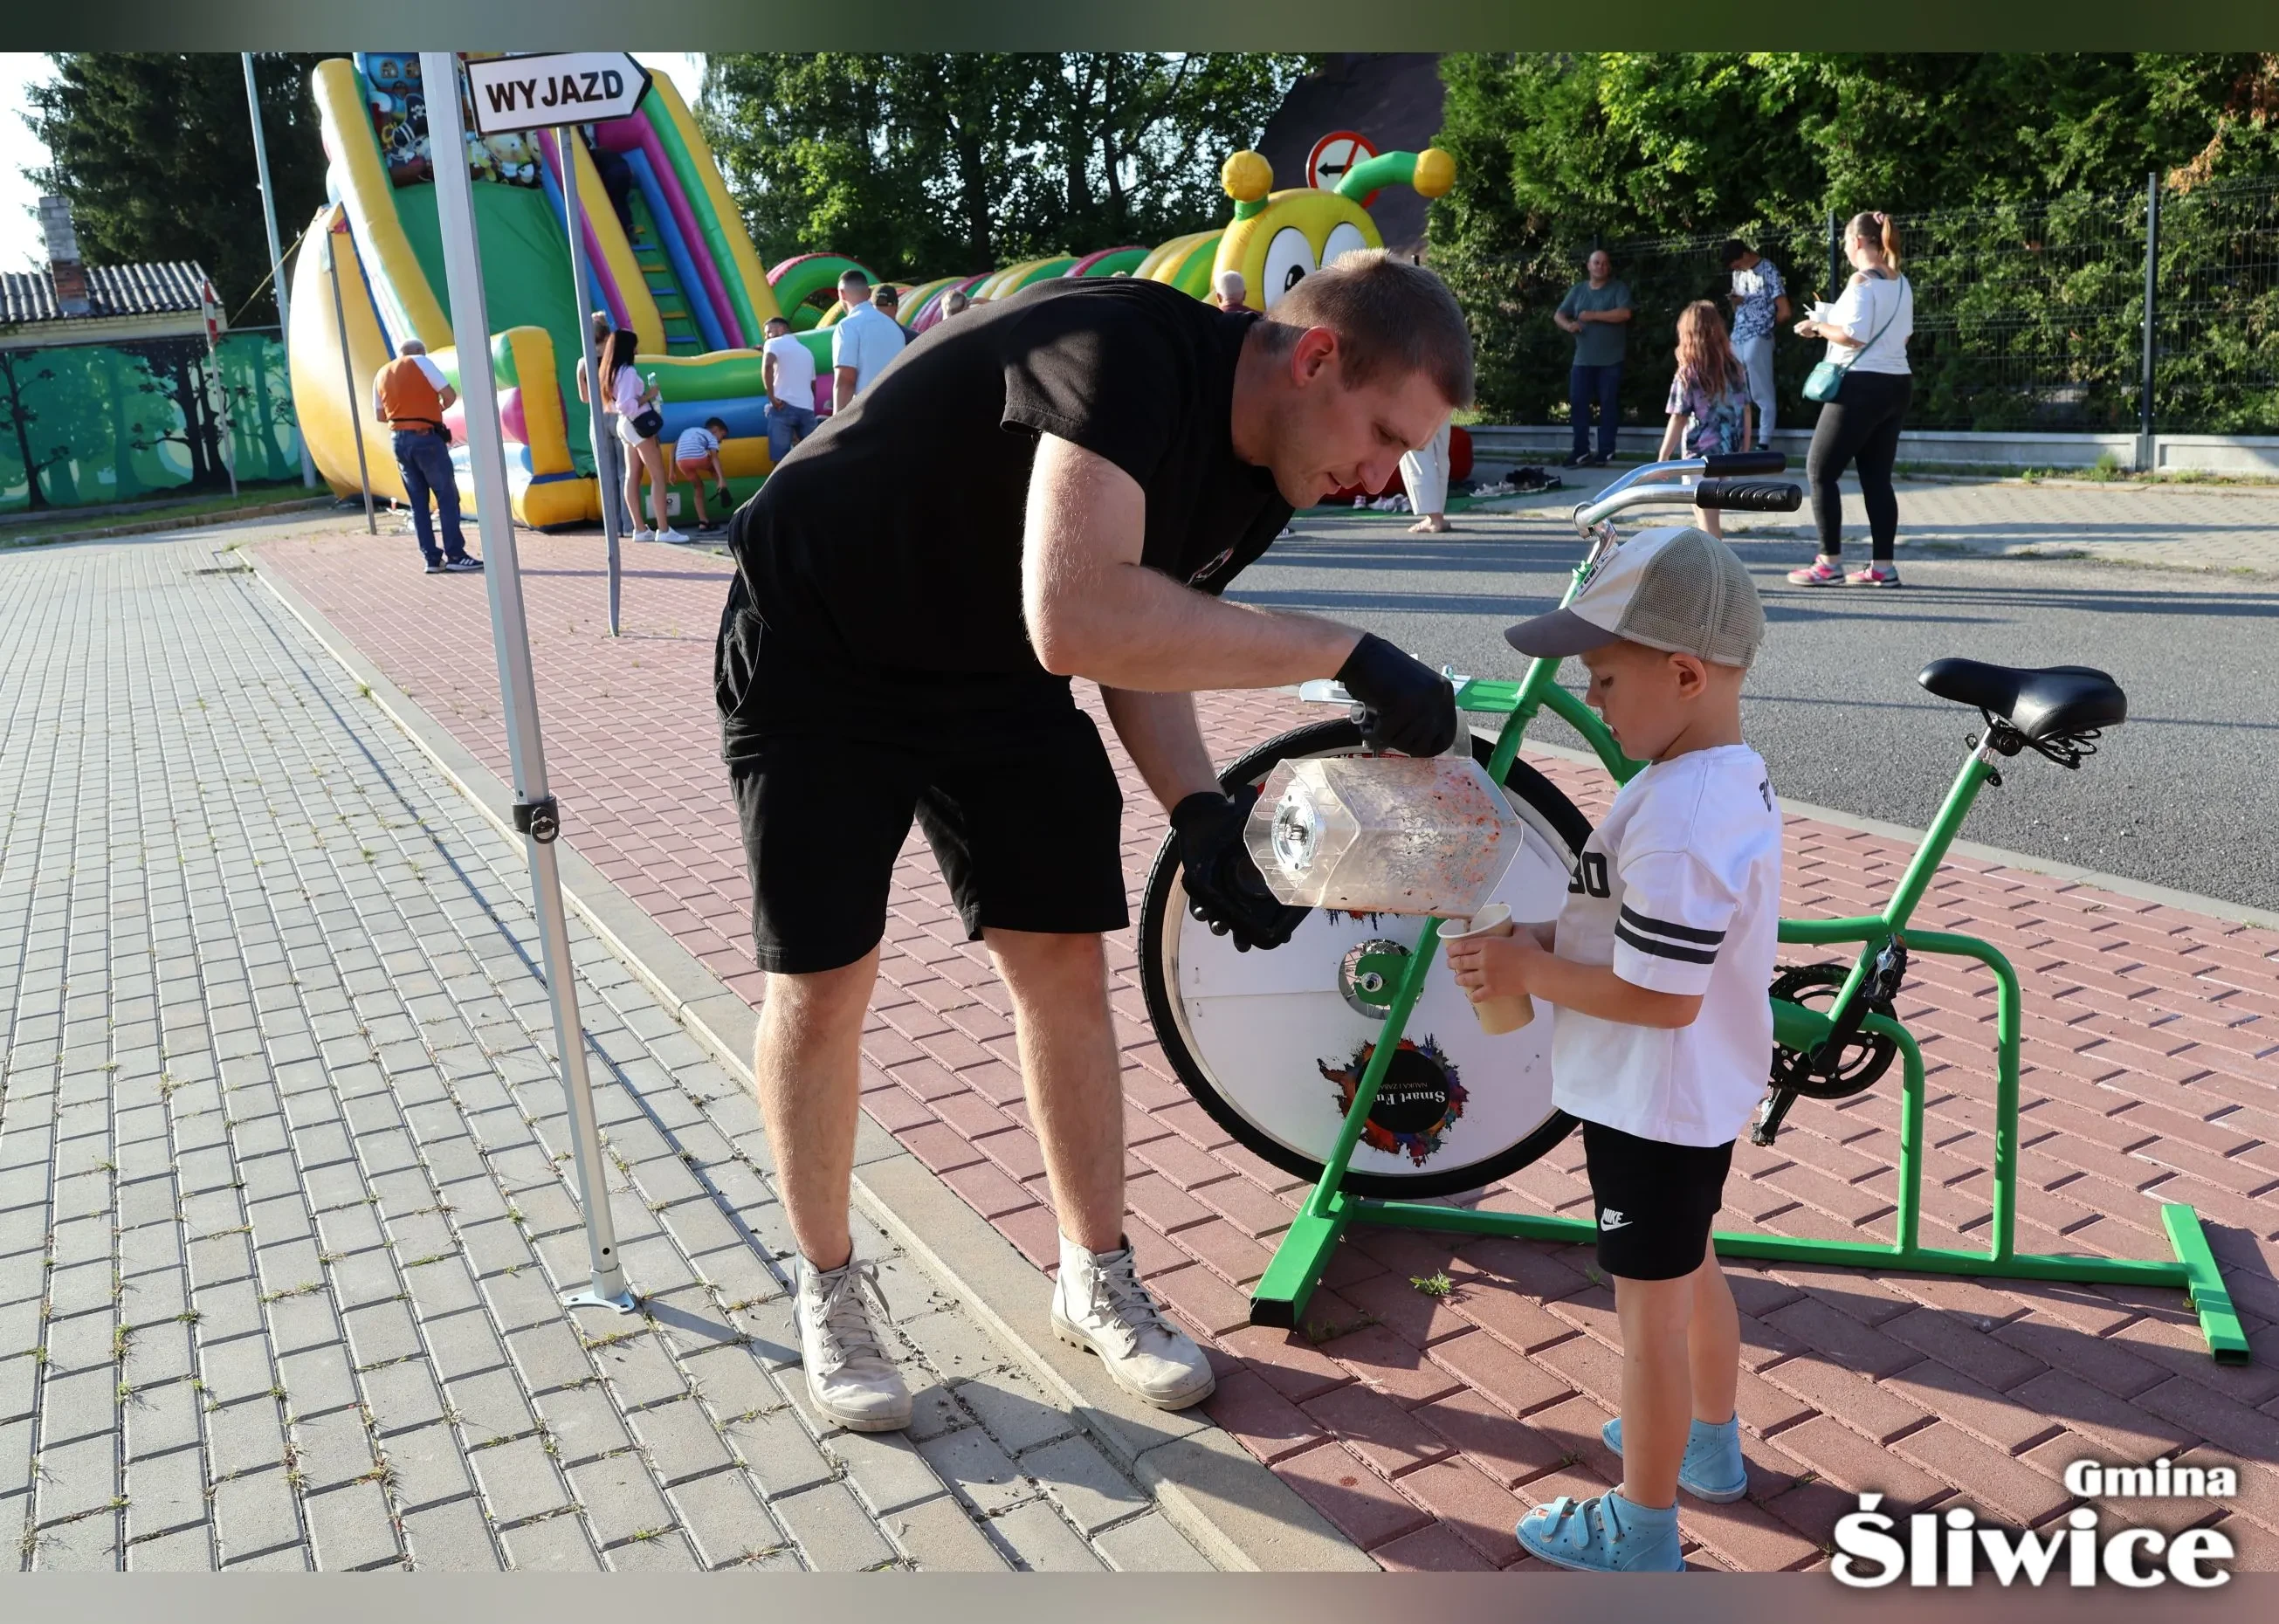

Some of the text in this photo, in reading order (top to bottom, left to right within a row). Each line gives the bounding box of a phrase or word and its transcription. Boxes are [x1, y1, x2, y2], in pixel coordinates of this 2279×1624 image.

[485, 69, 623, 114] WYJAZD
[1374, 1091, 1446, 1105] Smart Fu
[1603, 1208, 1623, 1225] NIKE
